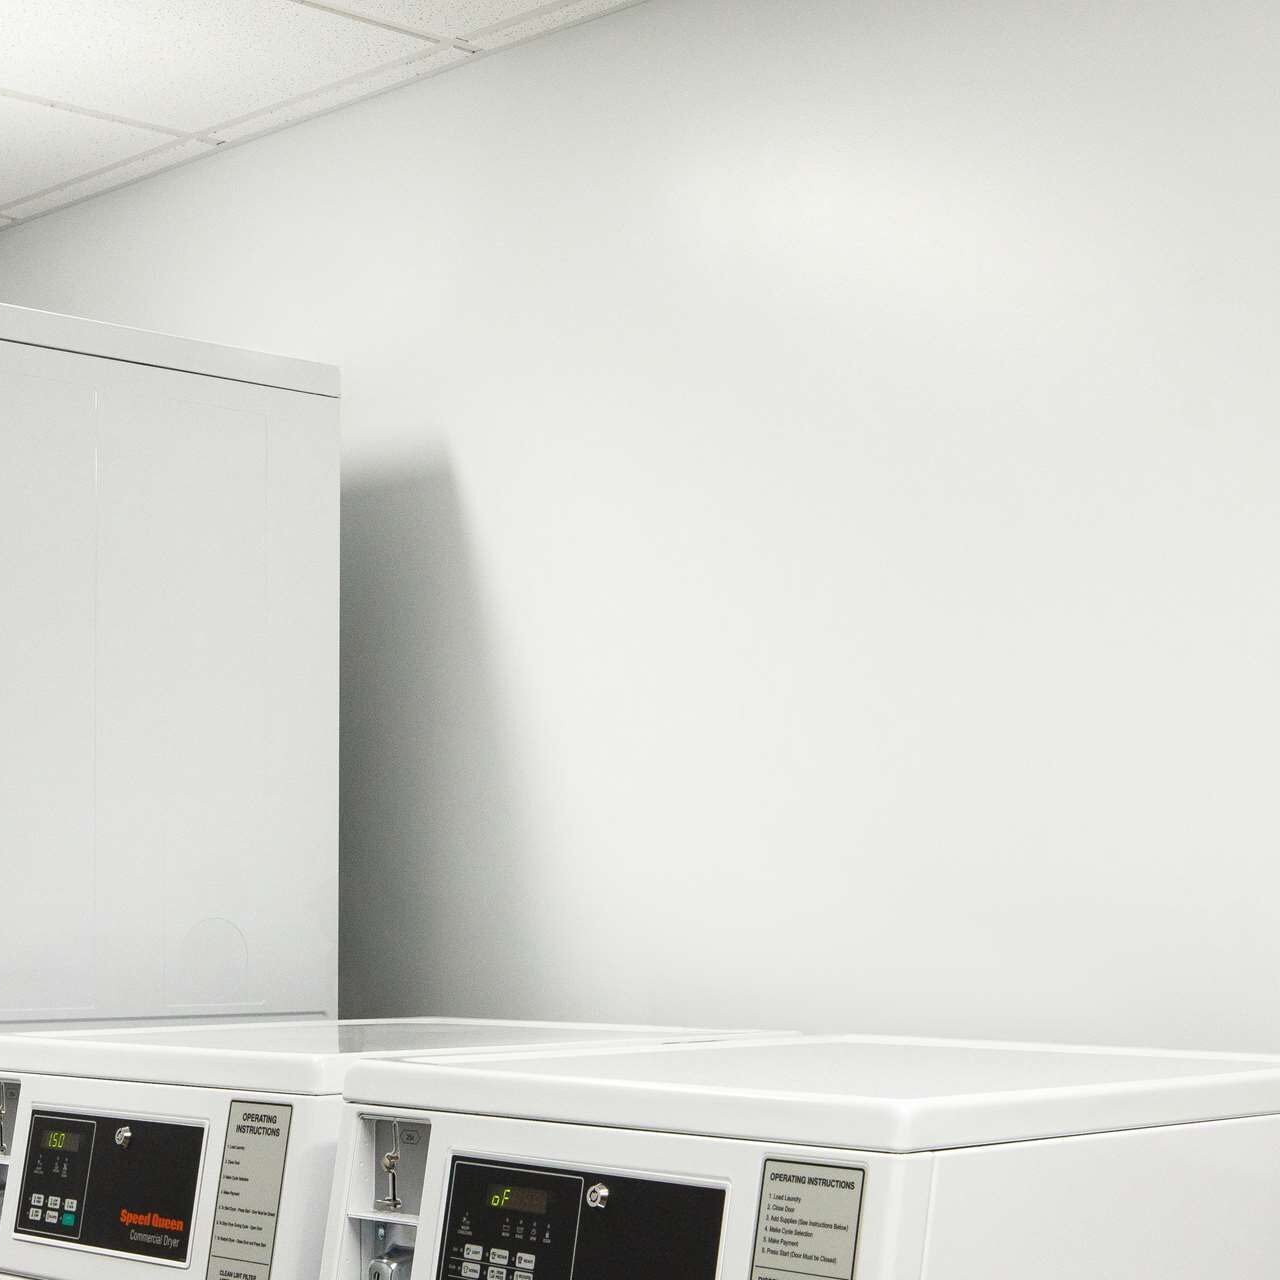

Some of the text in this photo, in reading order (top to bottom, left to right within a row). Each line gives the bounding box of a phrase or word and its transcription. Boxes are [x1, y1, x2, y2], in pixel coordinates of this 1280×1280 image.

[242, 1112, 277, 1124] OPERATING
[236, 1124, 280, 1137] INSTRUCTIONS
[770, 1172, 856, 1191] OPERATING INSTRUCTIONS
[120, 1208, 184, 1231] Speed Queen
[130, 1229, 180, 1249] Commercial Dryer
[219, 1270, 233, 1278] CLEAN
